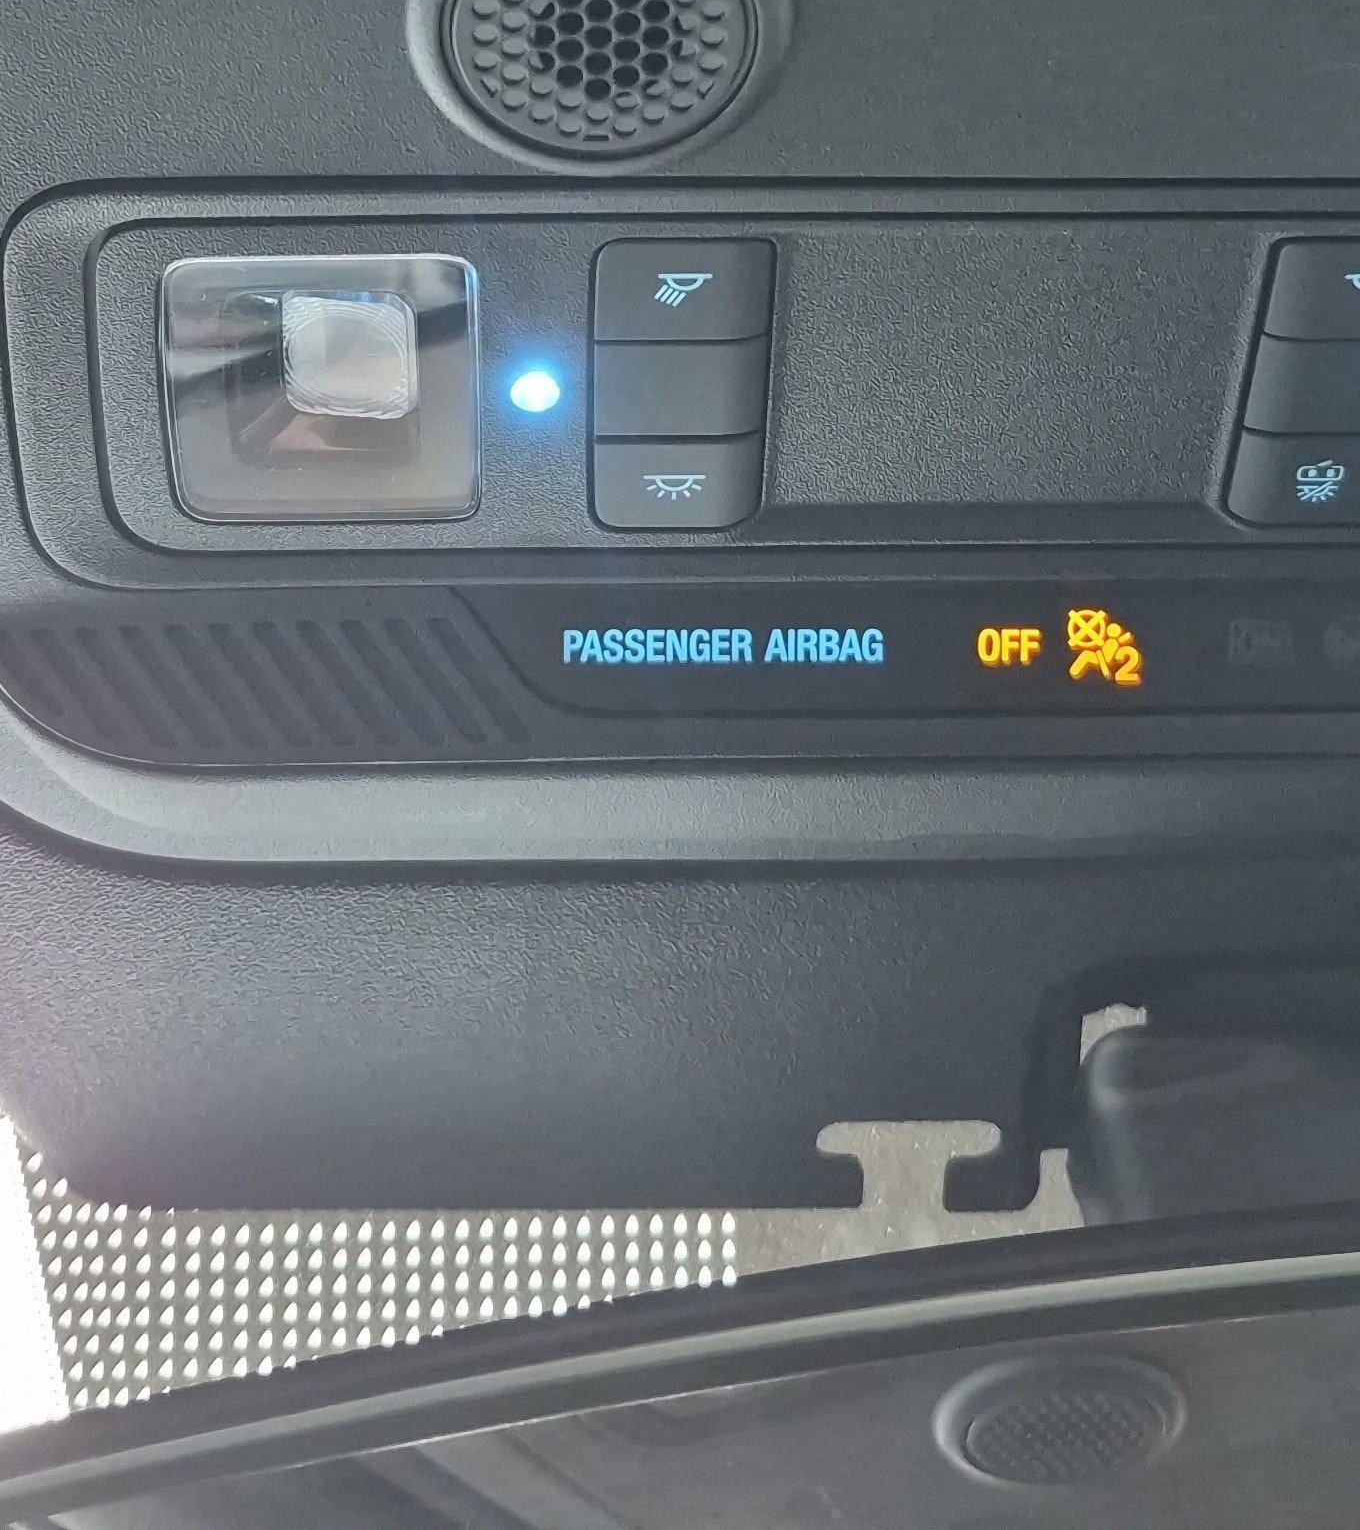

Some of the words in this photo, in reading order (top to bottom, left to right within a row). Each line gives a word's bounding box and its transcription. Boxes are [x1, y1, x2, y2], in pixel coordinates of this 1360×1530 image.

[562, 628, 754, 665] PASSENGER
[763, 628, 885, 665] AIRBAG
[976, 627, 1041, 666] OFF
